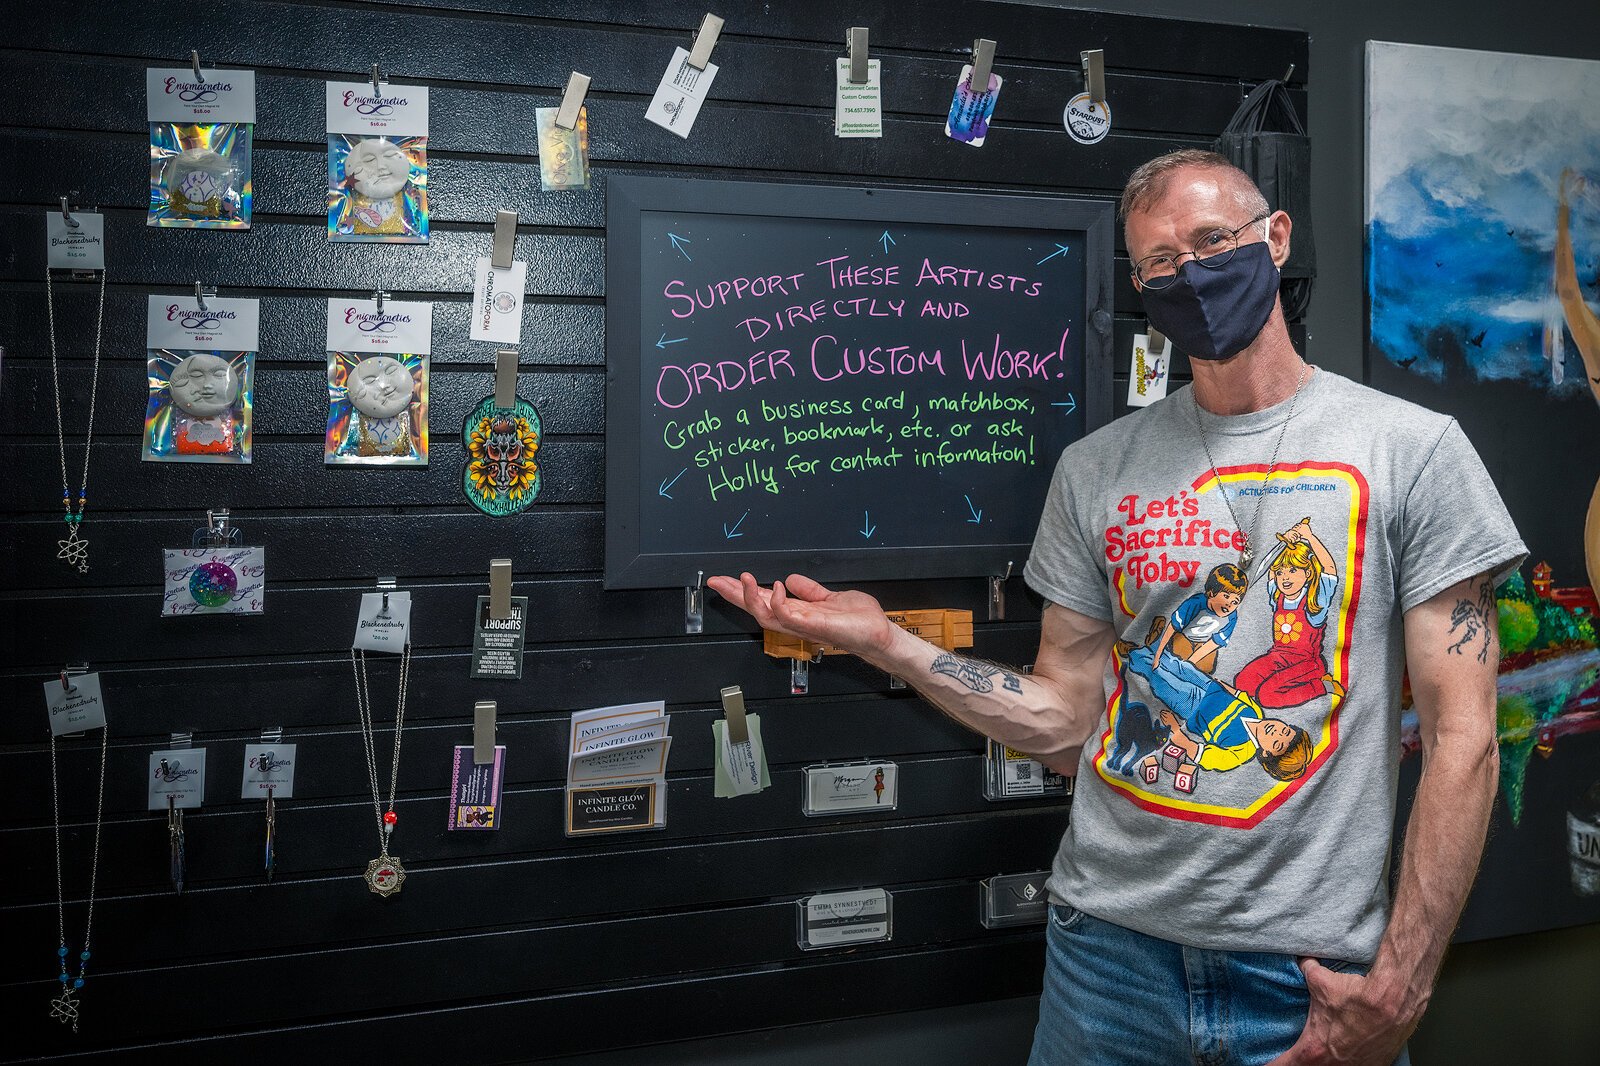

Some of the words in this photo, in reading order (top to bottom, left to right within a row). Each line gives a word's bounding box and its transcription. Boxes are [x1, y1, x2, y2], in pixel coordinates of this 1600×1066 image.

[1070, 107, 1106, 125] STARDUST
[662, 272, 805, 319] SUPPORT
[817, 255, 900, 291] THESE
[915, 257, 1043, 297] ARTISTS
[482, 270, 495, 331] CHROMATOFORM
[735, 298, 906, 343] DIRECTLY
[920, 300, 970, 319] AND
[656, 348, 796, 409] ORDER
[810, 334, 946, 381] CUSTOM
[961, 328, 1071, 380] WORK!
[662, 409, 722, 450] Grab
[736, 409, 749, 426] a
[761, 399, 853, 422] business
[928, 392, 1036, 415] matchbox,
[694, 436, 775, 469] sticker,
[784, 419, 893, 446] bookmark,
[900, 419, 940, 439] etc.
[949, 422, 971, 437] or
[987, 420, 1024, 438] ask
[707, 462, 779, 501] Holly
[785, 453, 820, 479] for
[830, 448, 902, 473] contact
[914, 442, 1035, 469] information!
[1295, 483, 1336, 492] CHILDREN
[1116, 490, 1199, 527] Let's
[1104, 517, 1248, 563] Sacrifice
[1126, 551, 1202, 591] Toby
[485, 619, 522, 630] SUPPORT
[585, 736, 626, 751] INFINITE
[627, 731, 656, 740] GLOW
[581, 751, 624, 763] INFINITE
[626, 747, 656, 756] GLOW
[749, 761, 758, 785] Design
[1149, 768, 1155, 780] 6
[1179, 776, 1187, 788] 6
[578, 795, 617, 806] INFINITE
[618, 794, 645, 803] GLOW
[585, 804, 621, 814] CANDLE
[834, 900, 877, 908] SYNNESTVEDT
